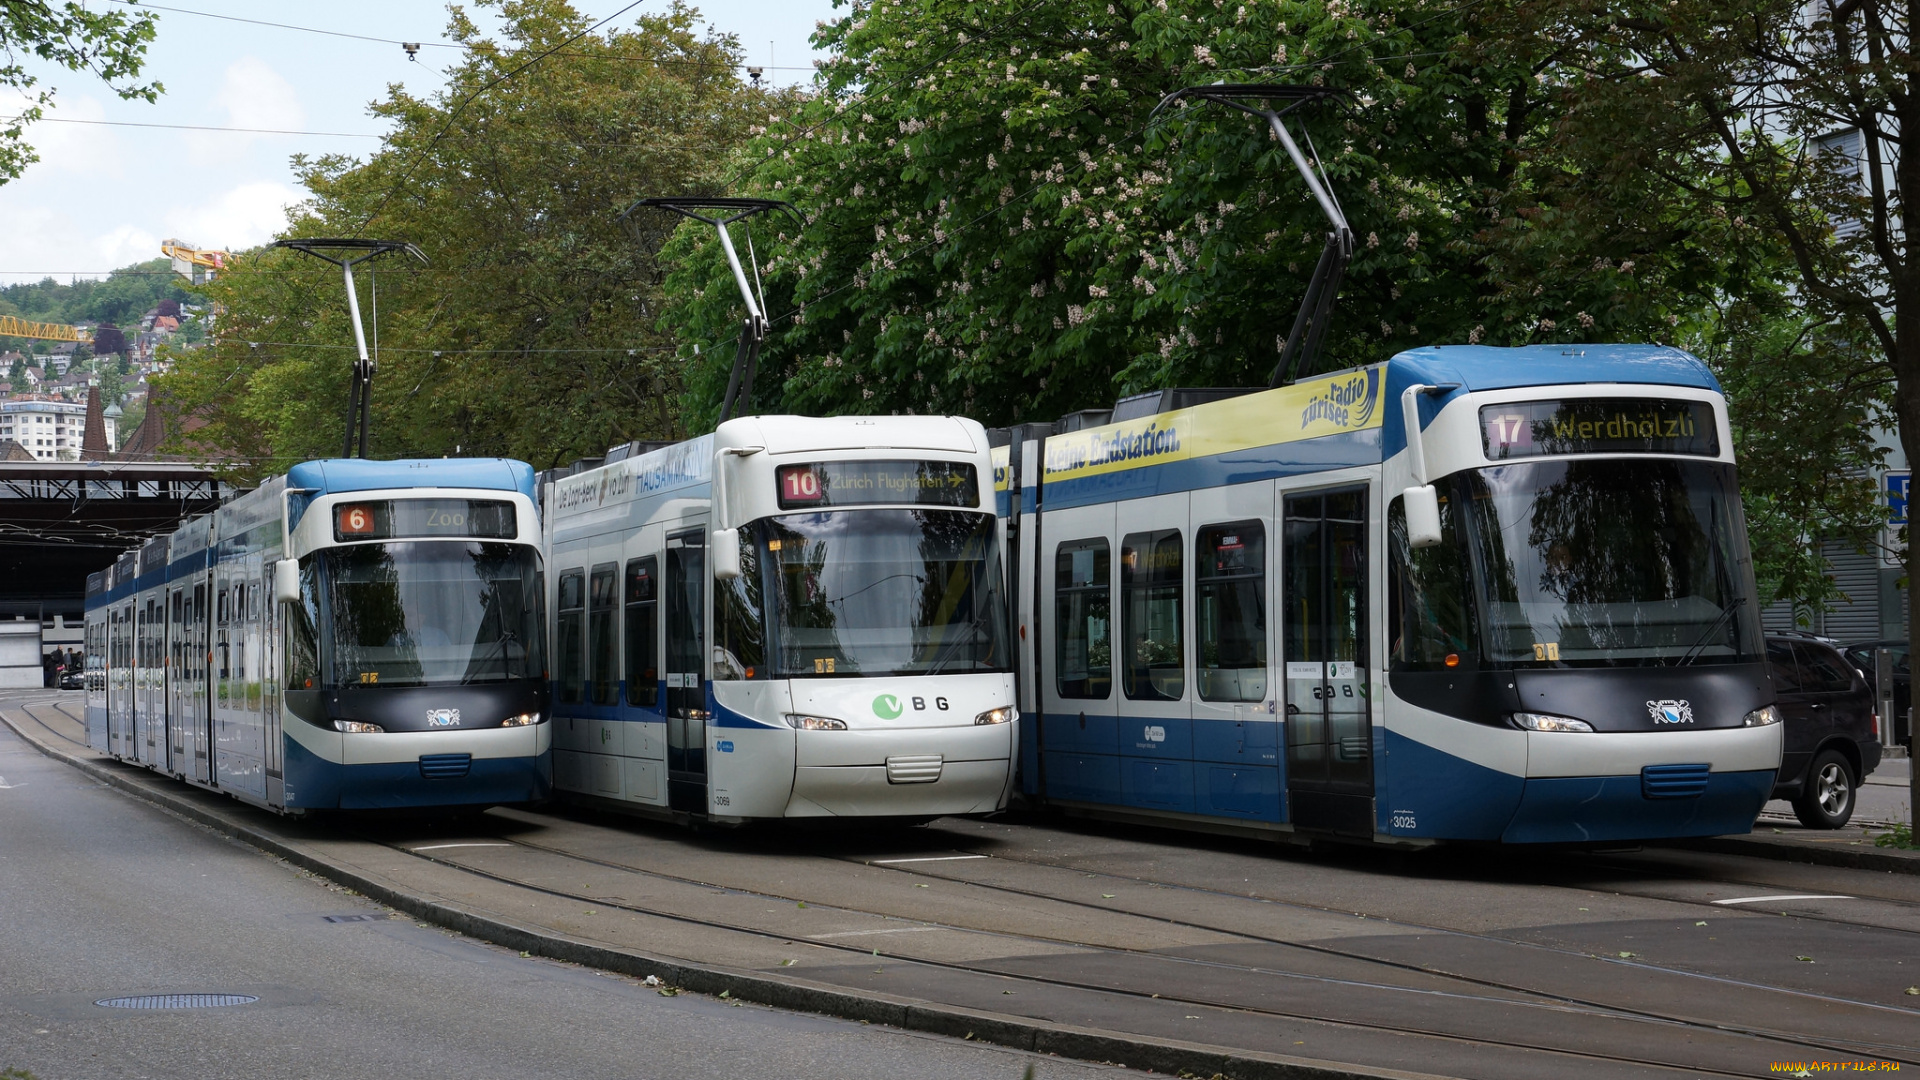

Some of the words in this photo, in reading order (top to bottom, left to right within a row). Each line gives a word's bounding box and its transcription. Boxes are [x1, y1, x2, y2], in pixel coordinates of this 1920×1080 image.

[1330, 377, 1365, 407] radio
[1301, 394, 1349, 430] zürisee
[1491, 414, 1525, 443] 17
[1552, 411, 1695, 439] Werdhölzli
[1045, 440, 1086, 474] keine
[1089, 422, 1181, 466] Endstation.
[787, 472, 817, 496] 10
[831, 473, 873, 490] Zürich
[878, 472, 943, 492] Flughafen
[350, 508, 365, 530] 6
[426, 508, 464, 527] Zoo
[1393, 815, 1417, 829] 3025
